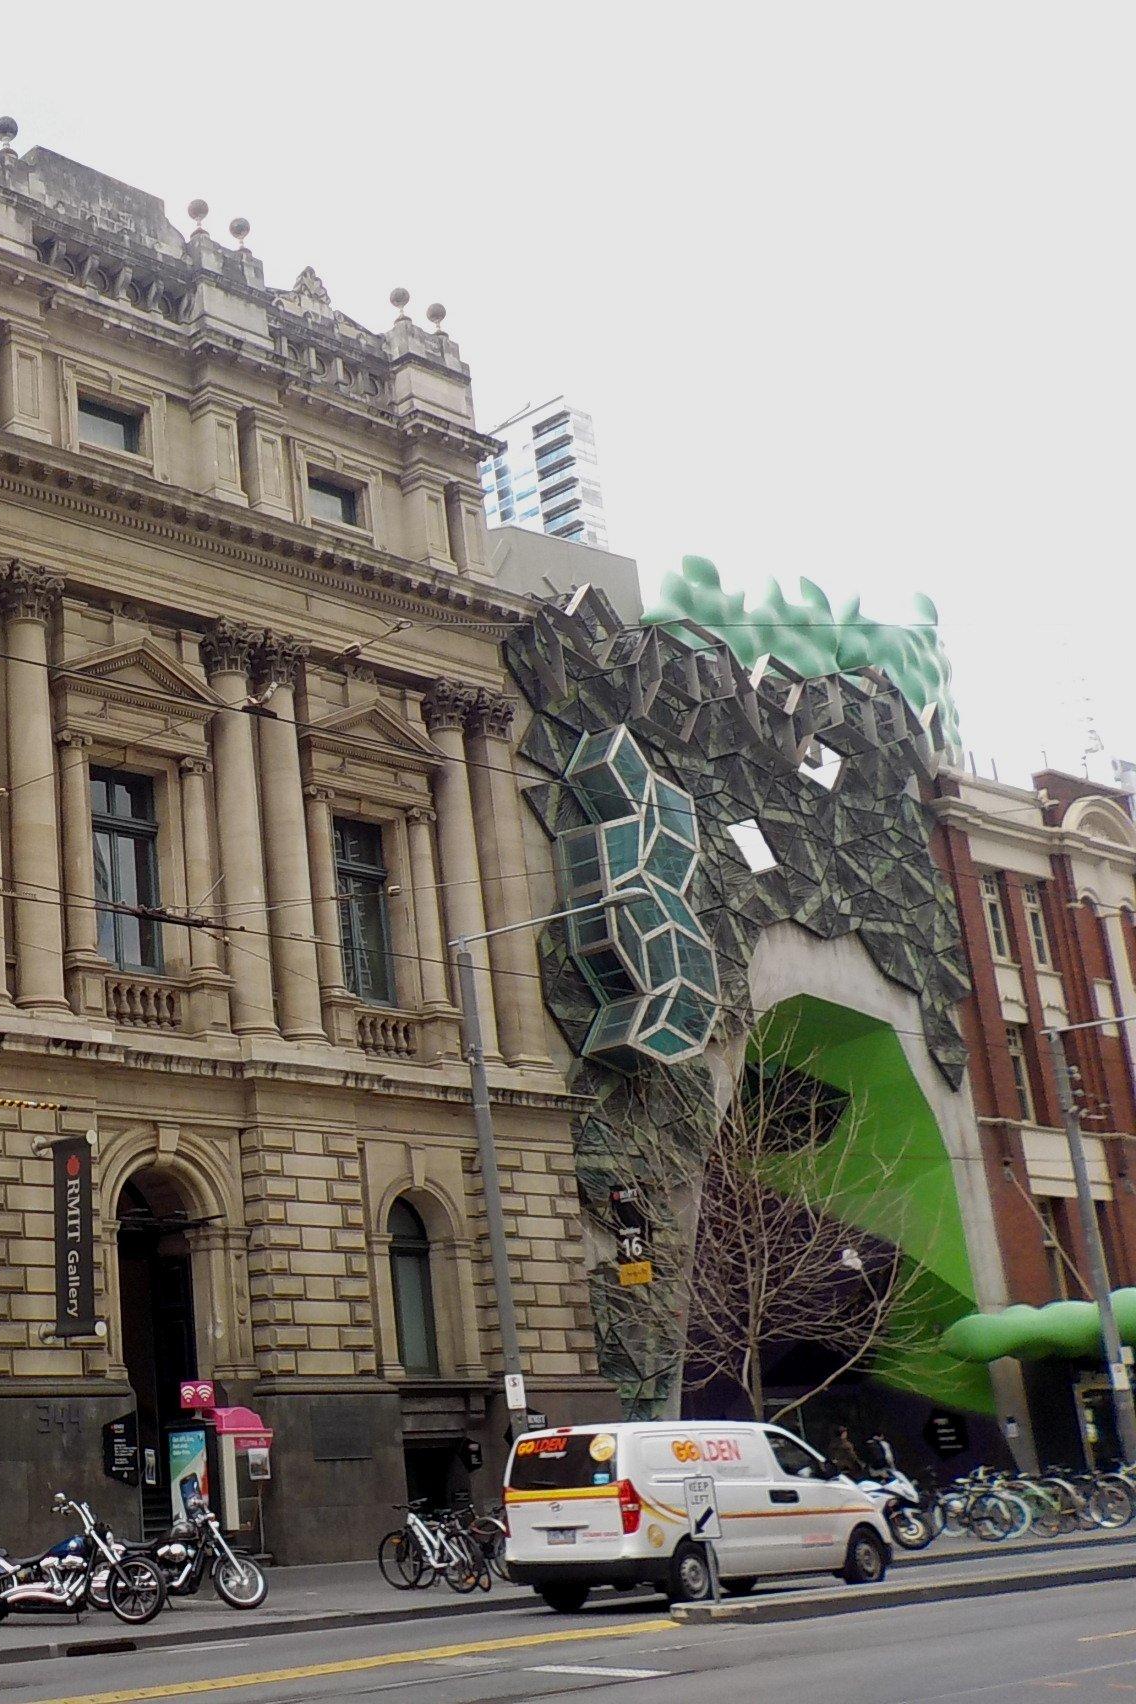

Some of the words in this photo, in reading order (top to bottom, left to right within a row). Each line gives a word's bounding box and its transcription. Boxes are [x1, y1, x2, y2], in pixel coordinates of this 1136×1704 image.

[67, 1179, 81, 1243] RMIT
[623, 1236, 643, 1257] 16
[67, 1250, 82, 1318] Gallery
[517, 1438, 567, 1456] GOLDEN
[671, 1440, 742, 1462] GOLDEN
[688, 1481, 709, 1492] KEEP
[690, 1494, 710, 1506] LEFT
